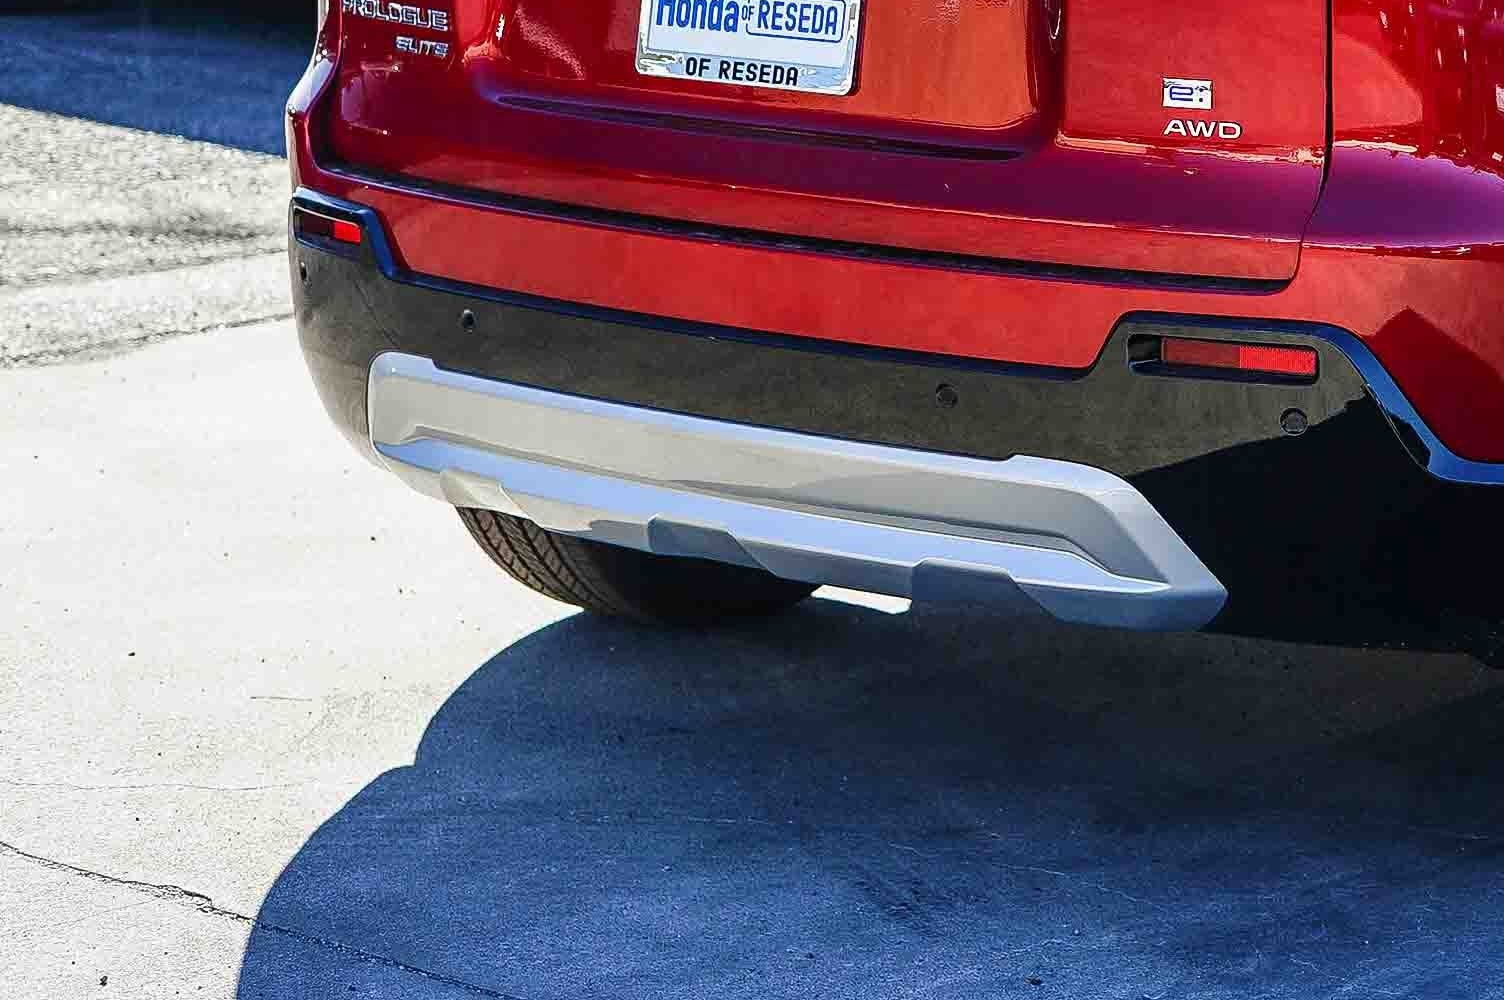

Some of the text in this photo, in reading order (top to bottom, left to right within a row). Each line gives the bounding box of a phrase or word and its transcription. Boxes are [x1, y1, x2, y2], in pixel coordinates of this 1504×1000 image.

[741, 5, 755, 21] OF
[757, 0, 839, 36] RESEDA
[395, 35, 449, 58] ELITE
[685, 57, 799, 86] OF RESEDA
[1163, 119, 1242, 139] AWD
